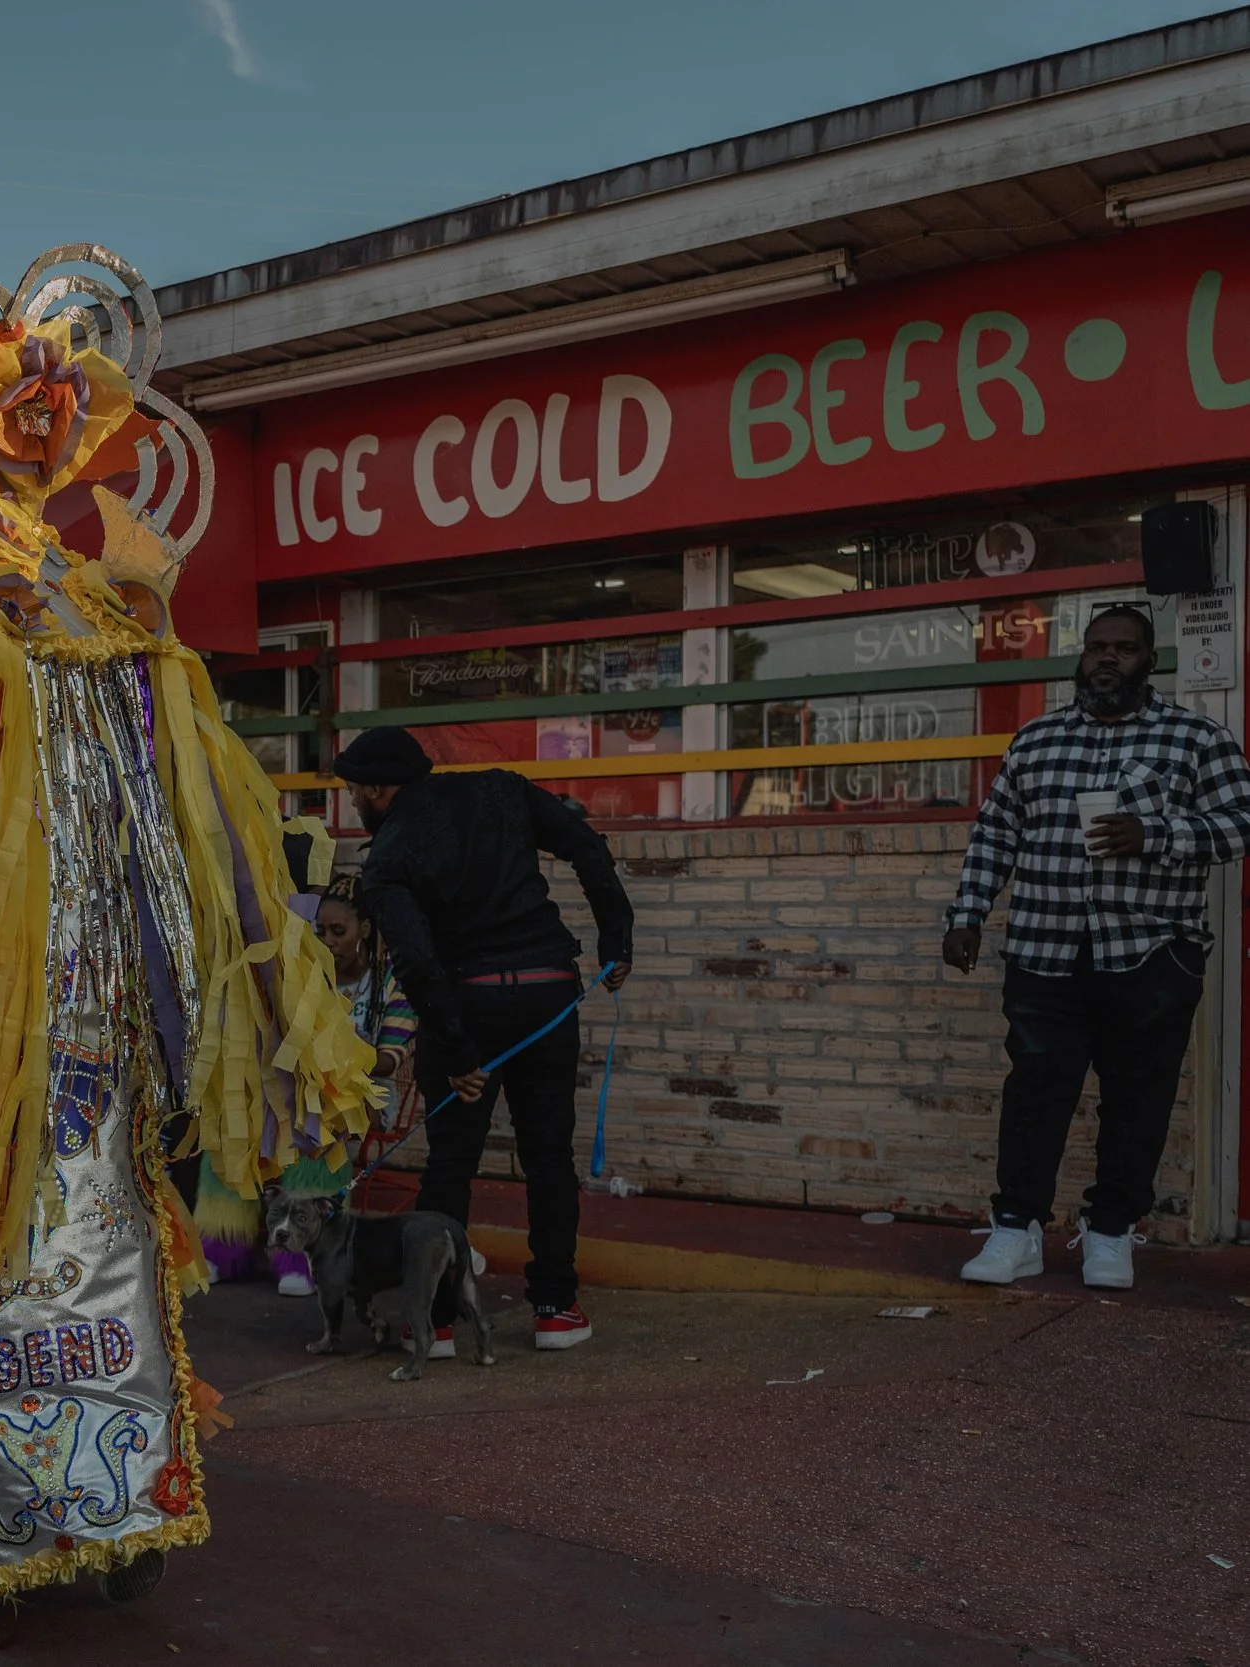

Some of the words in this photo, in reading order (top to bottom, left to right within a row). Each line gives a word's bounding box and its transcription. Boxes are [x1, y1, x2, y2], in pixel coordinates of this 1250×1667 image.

[273, 434, 382, 547] ICE
[413, 374, 672, 527] COLD
[729, 310, 1045, 480] BEER
[1191, 601, 1198, 611] IS
[1199, 599, 1223, 610] UNDER
[855, 608, 1033, 663] SAINTS
[1182, 623, 1232, 636] SURVEILLANCE
[414, 660, 528, 686] Budweiser
[813, 700, 940, 745] BUD
